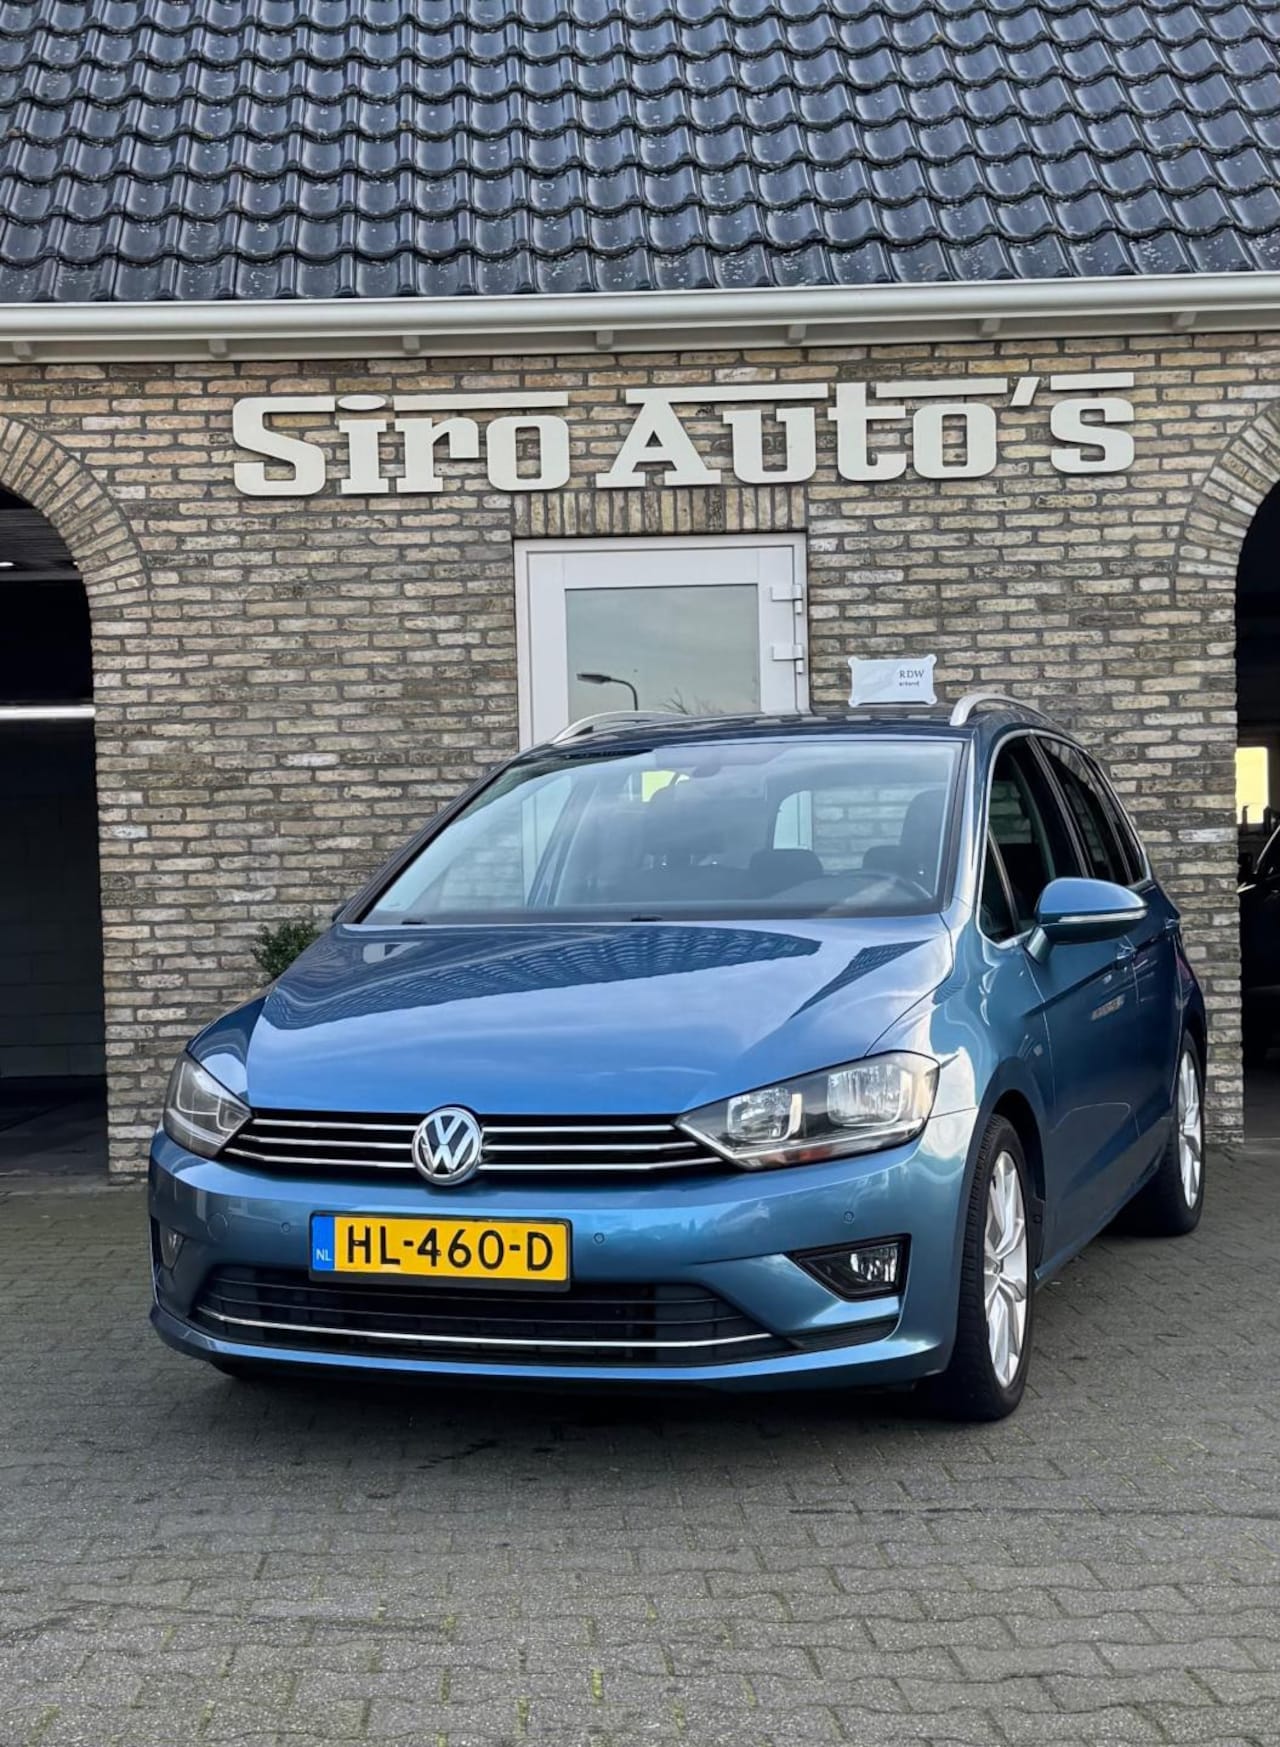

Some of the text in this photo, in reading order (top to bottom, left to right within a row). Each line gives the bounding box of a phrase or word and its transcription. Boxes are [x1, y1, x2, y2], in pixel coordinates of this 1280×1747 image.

[233, 372, 1135, 496] Siro Auto's
[899, 669, 925, 679] RDW
[414, 1109, 479, 1181] VW
[315, 1248, 333, 1262] NL
[347, 1224, 554, 1271] HL-460-D
